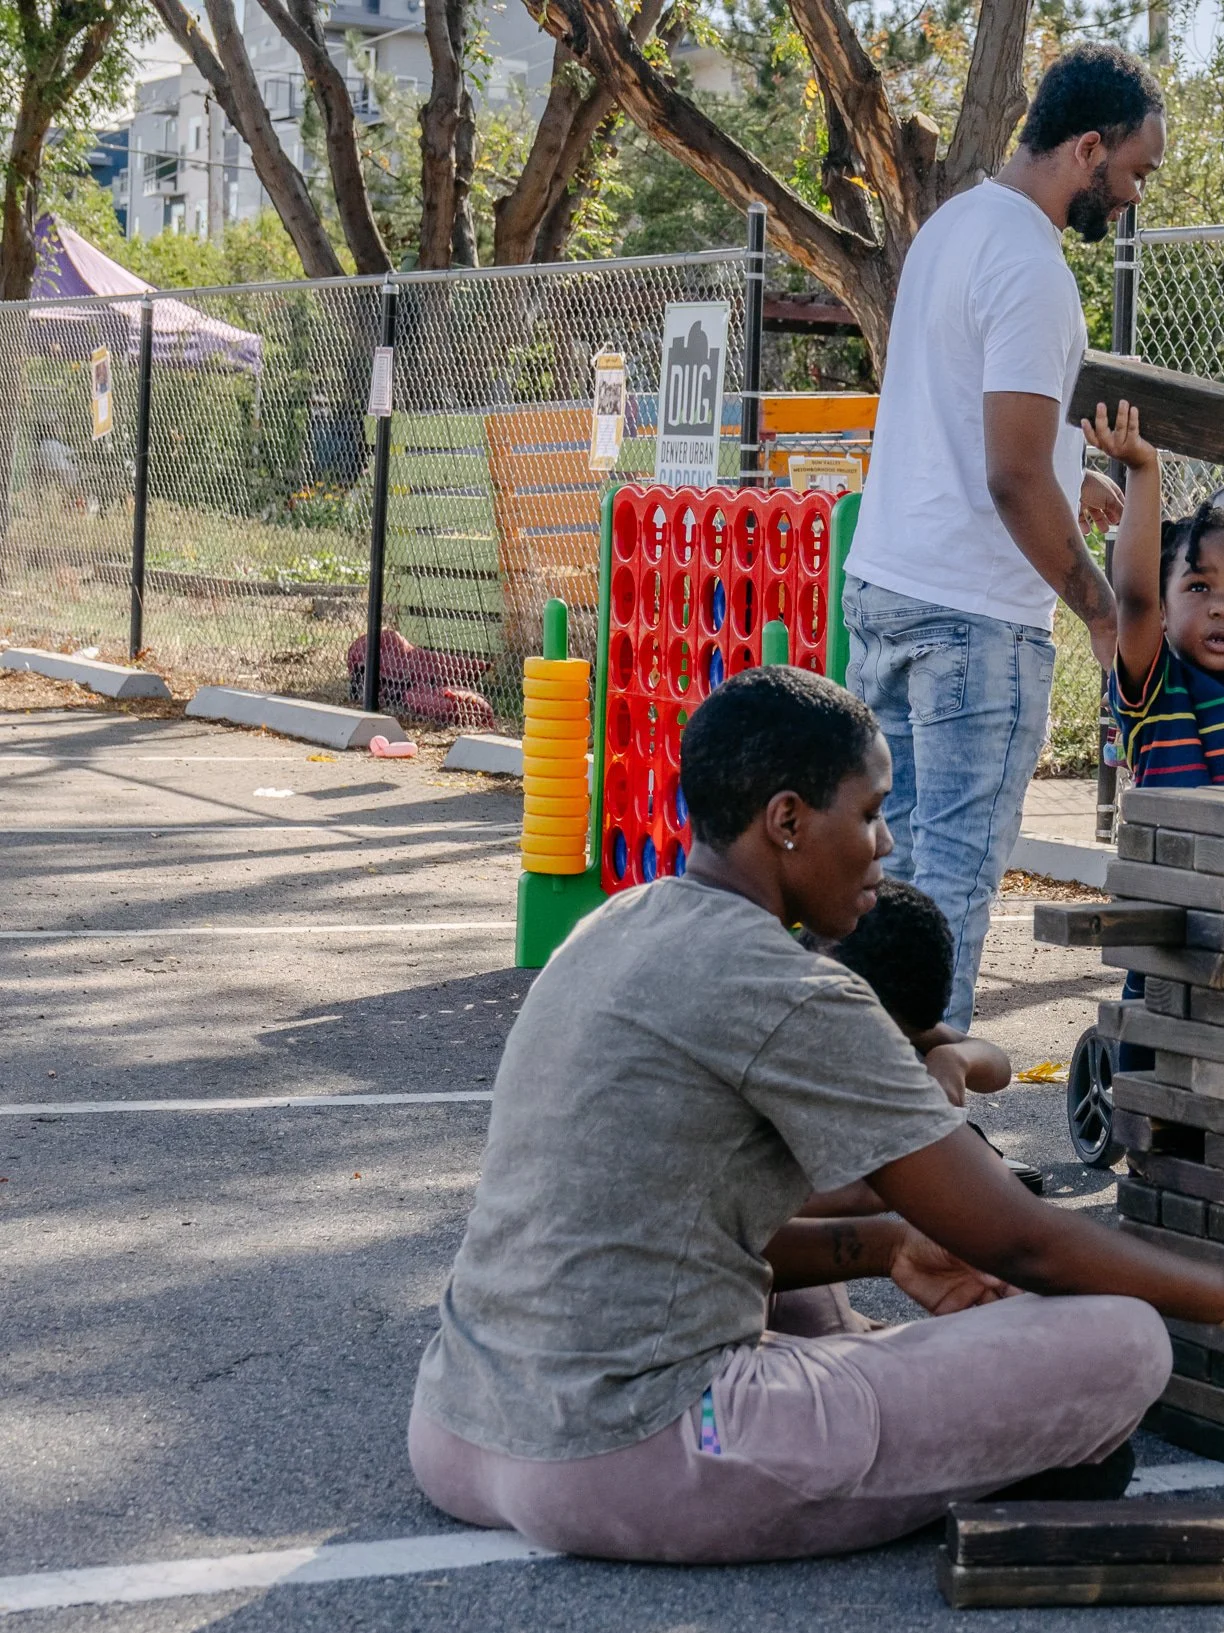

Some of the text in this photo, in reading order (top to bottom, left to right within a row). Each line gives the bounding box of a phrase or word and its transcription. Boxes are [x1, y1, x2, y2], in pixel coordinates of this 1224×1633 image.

[668, 364, 712, 426] DUG
[660, 441, 714, 464] DENVER URBAN
